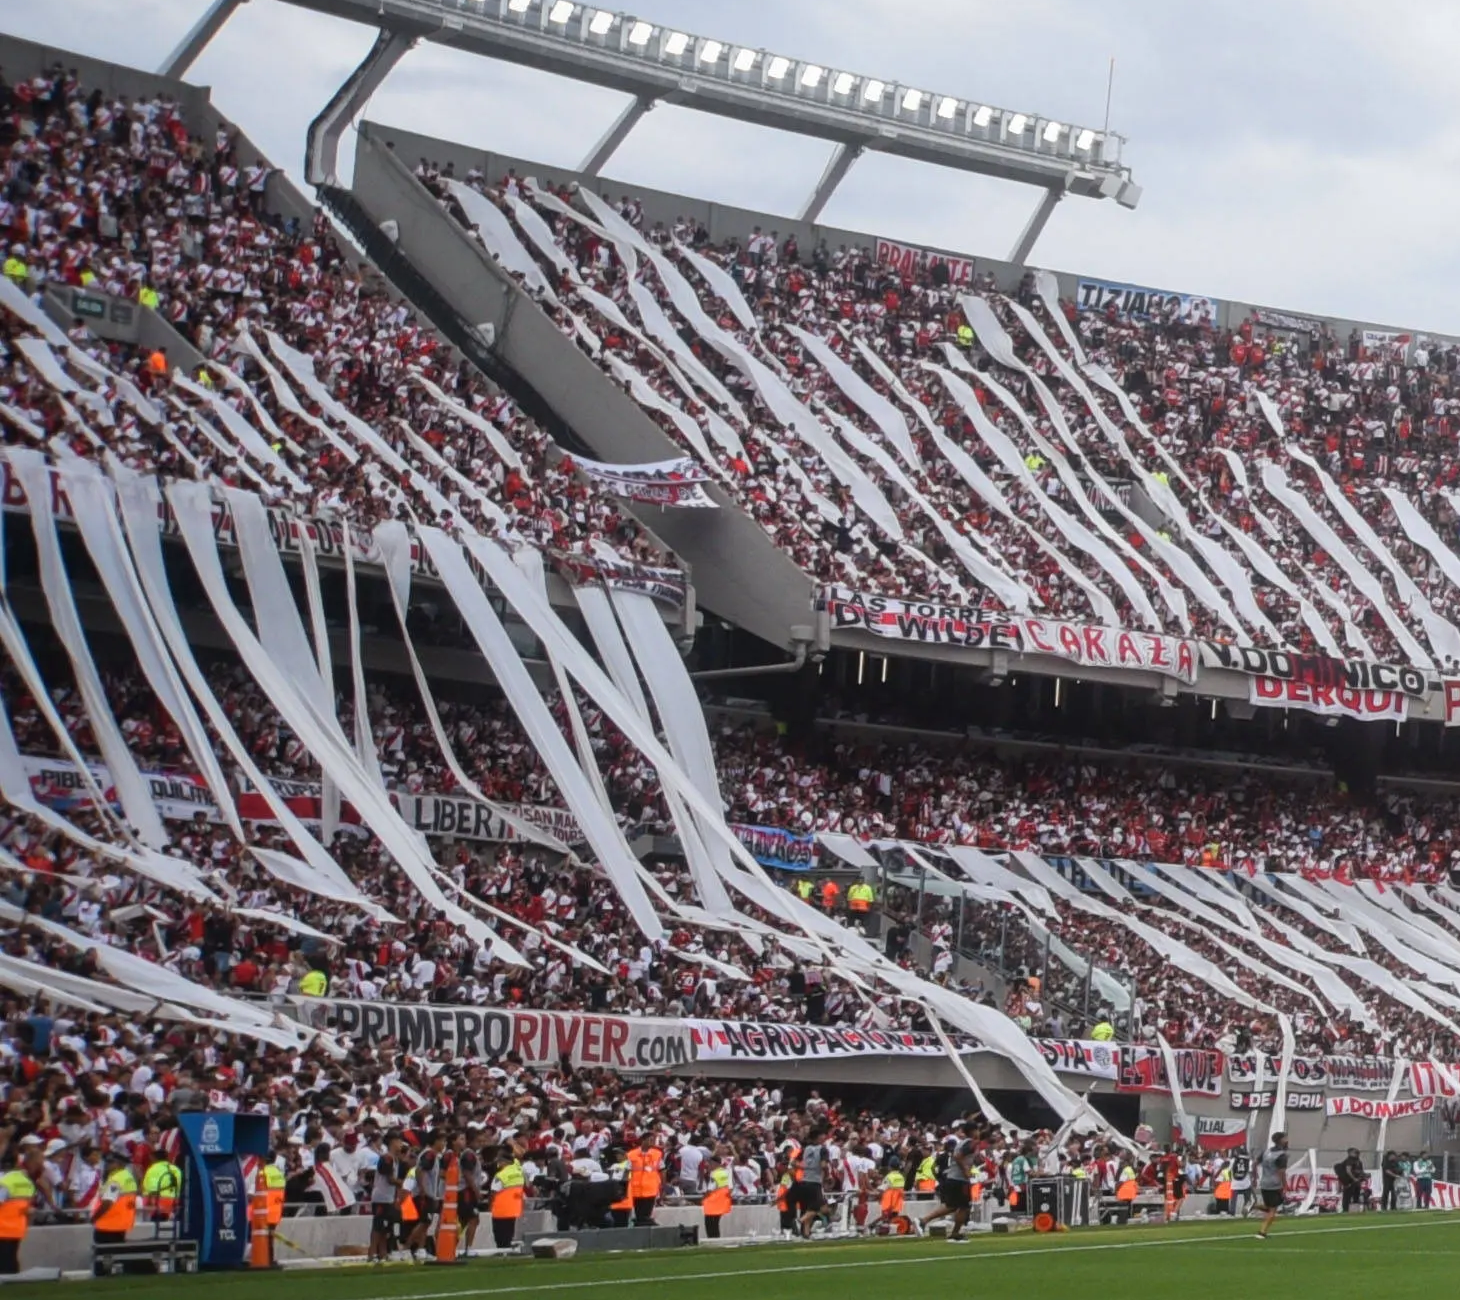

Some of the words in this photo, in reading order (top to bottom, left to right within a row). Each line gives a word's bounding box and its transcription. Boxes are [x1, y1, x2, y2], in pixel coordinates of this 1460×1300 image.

[831, 587, 887, 613] LAS
[902, 601, 1011, 623] TORRES
[835, 601, 882, 634] DE
[896, 617, 1012, 649] WILDE
[1249, 1093, 1269, 1108] DE
[1287, 1093, 1325, 1109] BRIL
[200, 1143, 222, 1153] TCL
[219, 1228, 237, 1241] TCL
